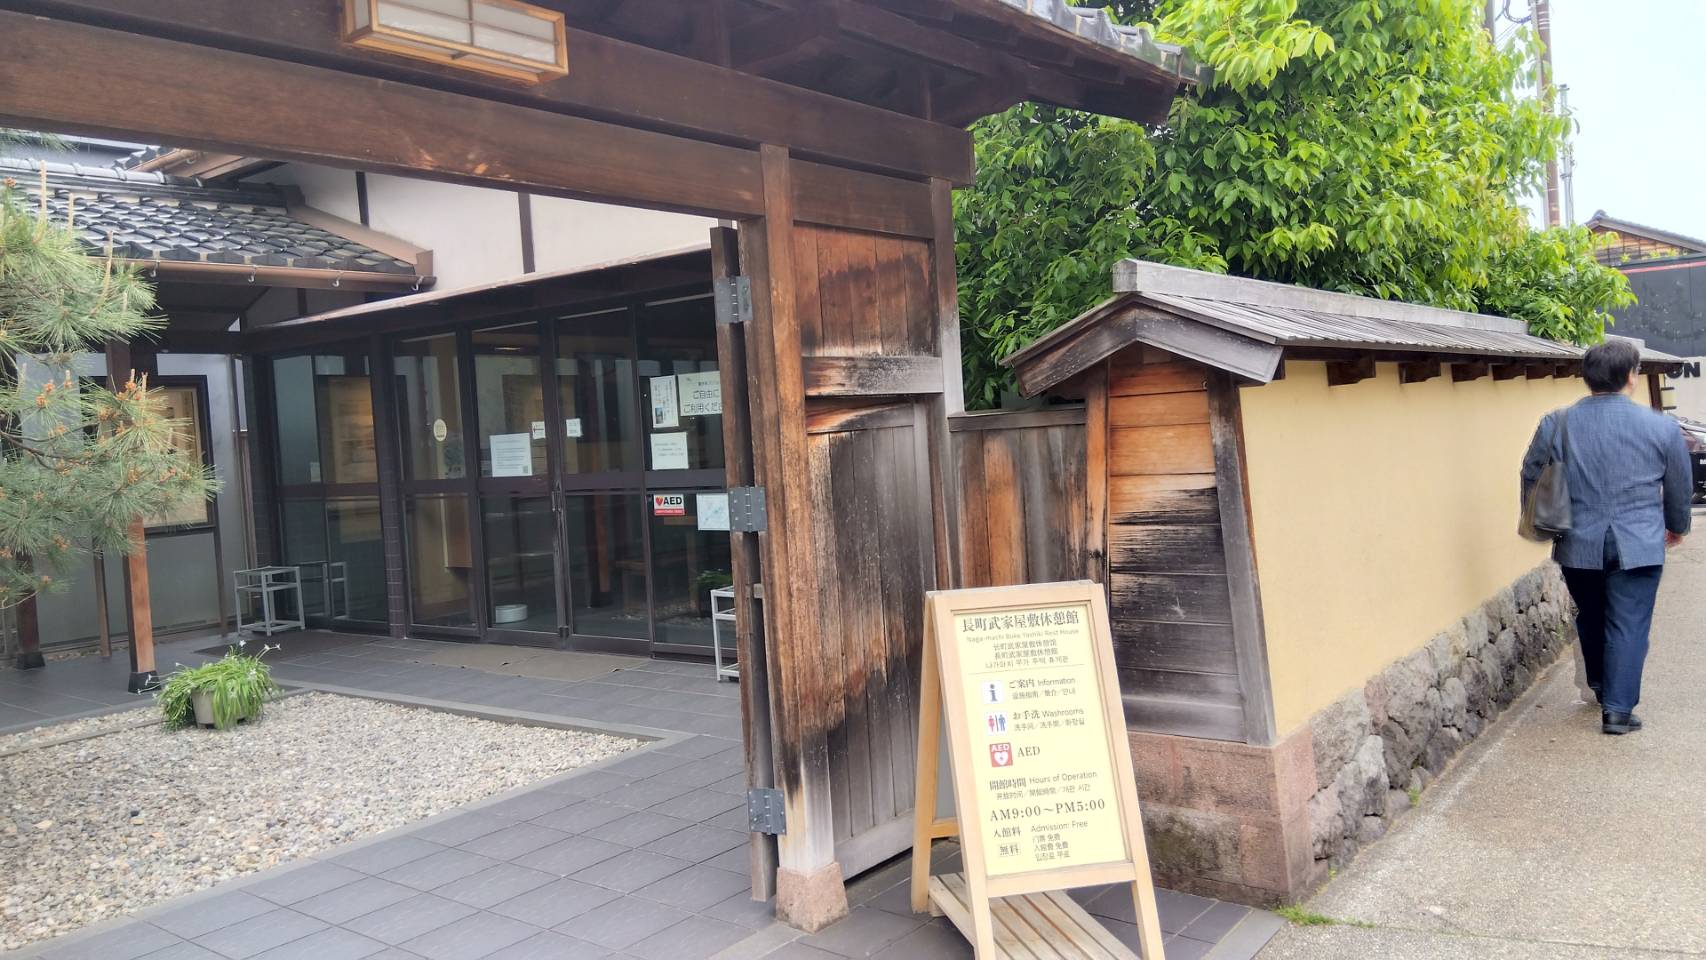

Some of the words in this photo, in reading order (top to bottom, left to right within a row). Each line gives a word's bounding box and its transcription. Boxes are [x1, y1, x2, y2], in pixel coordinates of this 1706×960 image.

[664, 497, 682, 505] AED
[963, 609, 1079, 632] 長町武家屋敷休憩館
[1060, 628, 1079, 636] House
[1009, 678, 1035, 689] ご案内
[1037, 677, 1076, 686] Information
[1012, 709, 1040, 720] お手洗
[1041, 708, 1085, 718] Washrooms
[991, 744, 1010, 752] AED
[1017, 746, 1041, 758] AED
[989, 776, 1027, 791] 開館時間
[1029, 777, 1051, 785] Hours
[1053, 774, 1060, 782] of
[1061, 771, 1097, 782] Operation
[990, 798, 1106, 822] AM9:00～PM5:00
[1071, 820, 1089, 828] Free
[993, 826, 1021, 838] 入館料
[999, 843, 1020, 856] 無料
